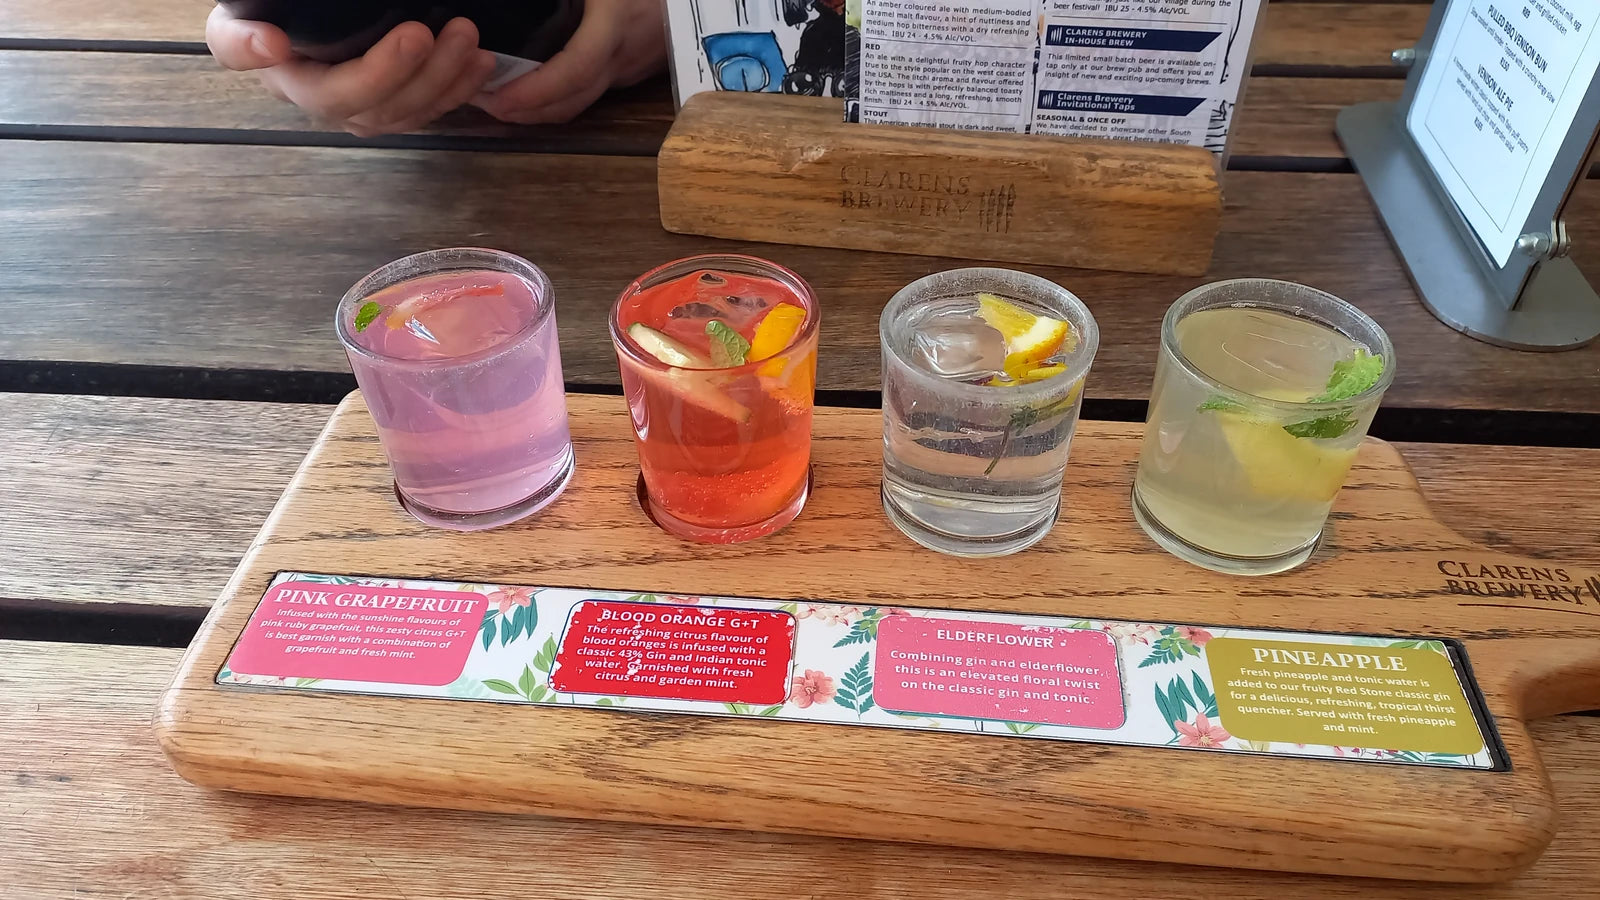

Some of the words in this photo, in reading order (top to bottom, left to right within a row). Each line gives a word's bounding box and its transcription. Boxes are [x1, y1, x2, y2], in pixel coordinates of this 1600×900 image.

[866, 9, 894, 17] caramel
[915, 12, 942, 22] flavour,
[951, 15, 966, 23] hint
[903, 3, 936, 11] coloured
[1064, 37, 1106, 45] IN-HOUSE
[1108, 38, 1134, 46] BREW
[1065, 28, 1104, 36] CLARENS
[1105, 30, 1147, 38] BREWERY
[1488, 4, 1505, 28] PULLED
[1504, 21, 1515, 40] BBQ
[1514, 31, 1536, 59] VENISON
[1534, 53, 1548, 73] BUN
[865, 42, 880, 50] RED
[1477, 64, 1498, 92] VENISON
[1495, 88, 1506, 103] ALE
[1504, 96, 1514, 112] PIE
[1056, 100, 1111, 109] Invitational
[1113, 102, 1135, 111] Taps
[1057, 92, 1092, 101] Clarens
[1094, 94, 1133, 104] Brewery
[864, 109, 888, 117] STOUT
[1036, 114, 1076, 122] SEASONAL
[840, 164, 970, 195] CLARENS
[840, 190, 972, 220] BREWERY
[1437, 560, 1572, 583] CLARENS
[274, 589, 334, 605] PINK
[334, 593, 479, 613] GRAPEFRUIT
[1445, 579, 1583, 605] BREWERY
[276, 608, 315, 617] Infused
[316, 611, 339, 619] with
[340, 612, 358, 620] the
[359, 614, 405, 622] sunshine
[406, 615, 447, 625] flavours
[449, 618, 462, 626] of
[600, 609, 656, 623] BLOOD
[660, 613, 726, 627] ORANGE
[730, 618, 759, 629] G+T
[259, 619, 284, 627] pink
[284, 621, 309, 630] ruby
[308, 623, 362, 633] grapefruit,
[365, 624, 384, 633] this
[385, 627, 413, 636] zesty
[414, 627, 443, 636] citrus
[445, 629, 467, 637] G+T
[587, 625, 608, 633] The
[610, 627, 671, 639] refreshing
[673, 630, 707, 640] citrus
[710, 632, 753, 643] flavour
[755, 635, 769, 644] of
[264, 630, 274, 638] is
[275, 631, 298, 640] best
[297, 634, 336, 642] garnish
[338, 635, 361, 643] with
[372, 637, 436, 647] combination
[582, 635, 616, 645] blood
[618, 639, 666, 650] oranges
[669, 641, 678, 649] is
[681, 641, 726, 652] infused
[729, 645, 755, 654] with
[937, 629, 1053, 648] ELDERFLOWER
[284, 645, 337, 654] grapefruit
[338, 647, 360, 655] and
[360, 647, 387, 656] fresh
[388, 650, 415, 658] mint.
[576, 646, 615, 657] classic
[618, 649, 643, 659] 43%
[646, 651, 666, 660] Gin
[669, 653, 692, 661] and
[695, 654, 733, 664] Indian
[737, 657, 767, 666] tonic
[890, 650, 962, 665] Combining
[965, 656, 986, 666] gin
[990, 659, 1015, 668] and
[1251, 647, 1407, 671] PINEAPPLE
[585, 658, 623, 669] water.
[627, 661, 689, 673] Garnished
[692, 665, 719, 675] with
[722, 667, 753, 677] fresh
[895, 664, 920, 674] this
[924, 666, 935, 675] is
[939, 669, 955, 677] an
[959, 669, 1019, 682] elevated
[1023, 674, 1060, 686] floral
[1064, 679, 1100, 689] twist
[1240, 667, 1271, 676] Fresh
[1273, 670, 1328, 681] pineapple
[1331, 674, 1352, 682] and
[1354, 675, 1383, 684] tonic
[1384, 678, 1417, 686] water
[1419, 678, 1430, 687] is
[595, 671, 630, 681] citrus
[633, 674, 656, 683] and
[658, 676, 702, 686] garden
[705, 678, 737, 688] mint.
[922, 681, 944, 691] the
[948, 683, 994, 695] classic
[998, 688, 1019, 698] gin
[1023, 691, 1049, 700] and
[1053, 692, 1094, 704] tonic.
[1227, 679, 1262, 688] added
[1264, 681, 1277, 689] to
[1301, 683, 1332, 695] fruity
[1335, 685, 1357, 694] Red
[1359, 687, 1392, 697] Stone
[1395, 689, 1431, 699] classic
[1432, 692, 1451, 702] gin
[1230, 690, 1247, 699] for
[1259, 692, 1313, 705] delicious,
[1315, 697, 1376, 710] refreshing,
[1378, 701, 1422, 711] tropical
[1424, 703, 1456, 713] thirst
[1237, 705, 1294, 715] quencher.
[1296, 708, 1336, 718] Served
[1337, 711, 1365, 720] with
[1366, 712, 1396, 722] fresh
[1398, 715, 1456, 727] pineapple
[1322, 723, 1345, 732] and
[1347, 724, 1378, 734] mint.
